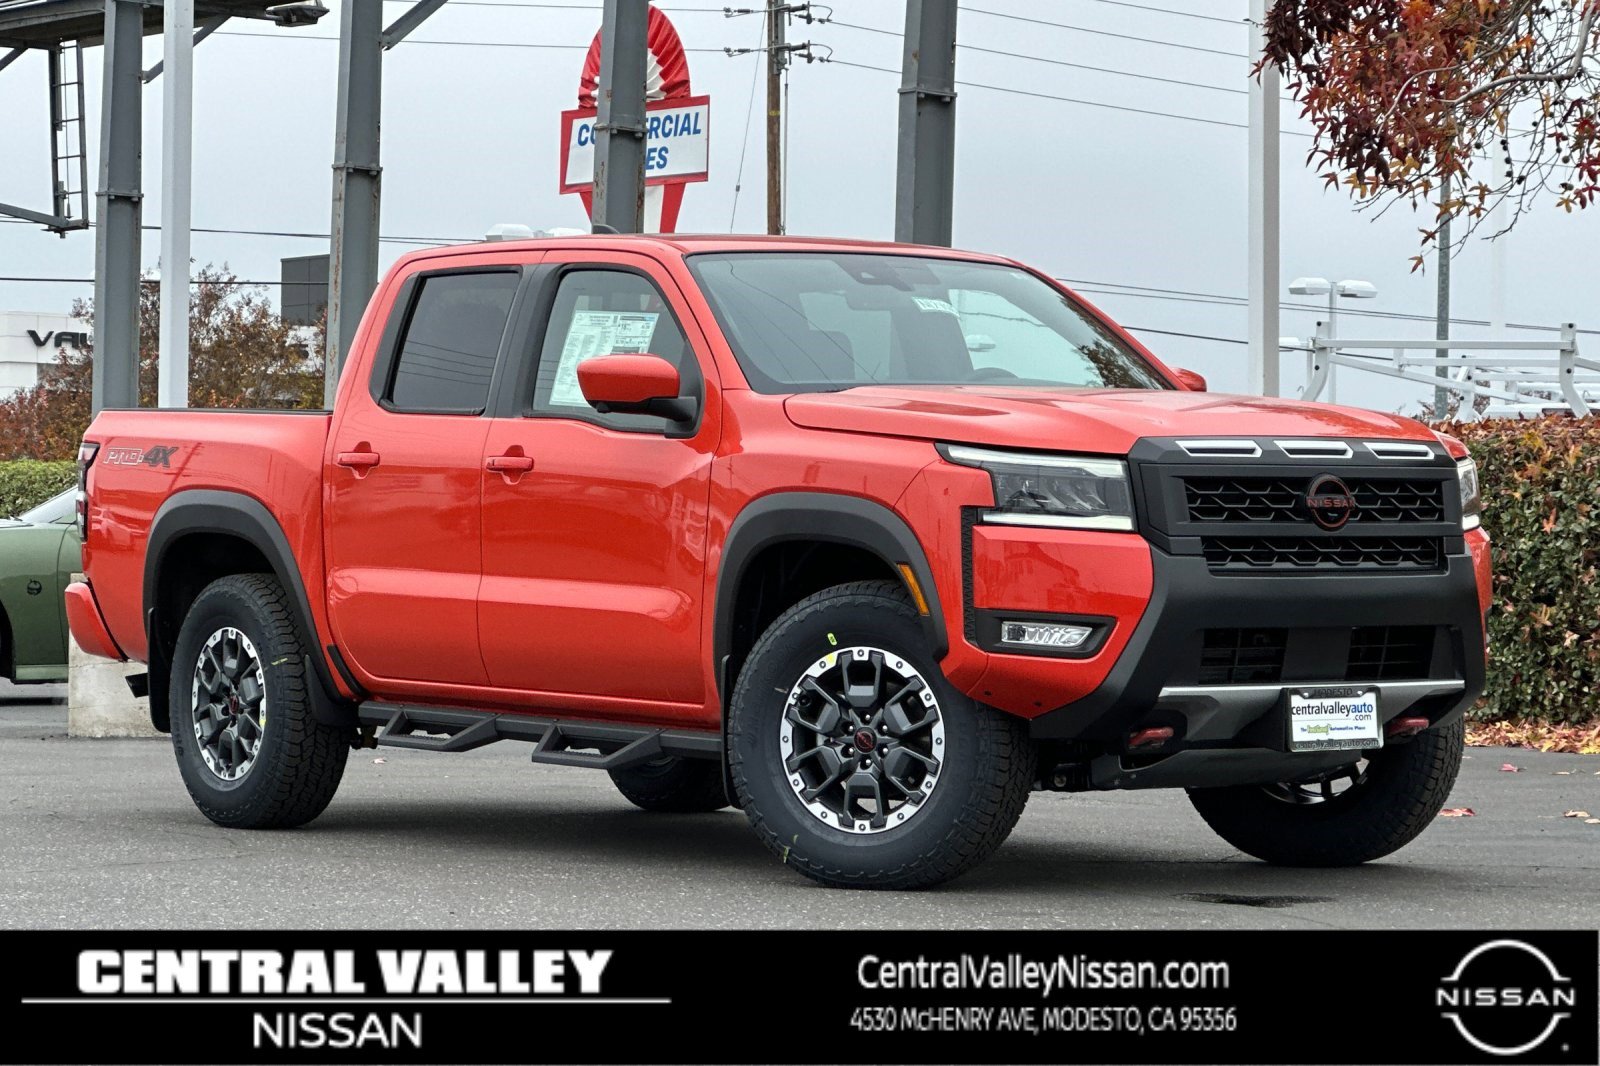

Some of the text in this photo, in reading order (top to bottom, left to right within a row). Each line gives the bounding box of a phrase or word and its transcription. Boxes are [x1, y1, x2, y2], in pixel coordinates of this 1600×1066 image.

[577, 112, 702, 147] CRCIAL
[103, 445, 180, 468] PRO-4X
[1306, 498, 1356, 508] NISSAN
[1292, 701, 1373, 716] centralvalleyauto
